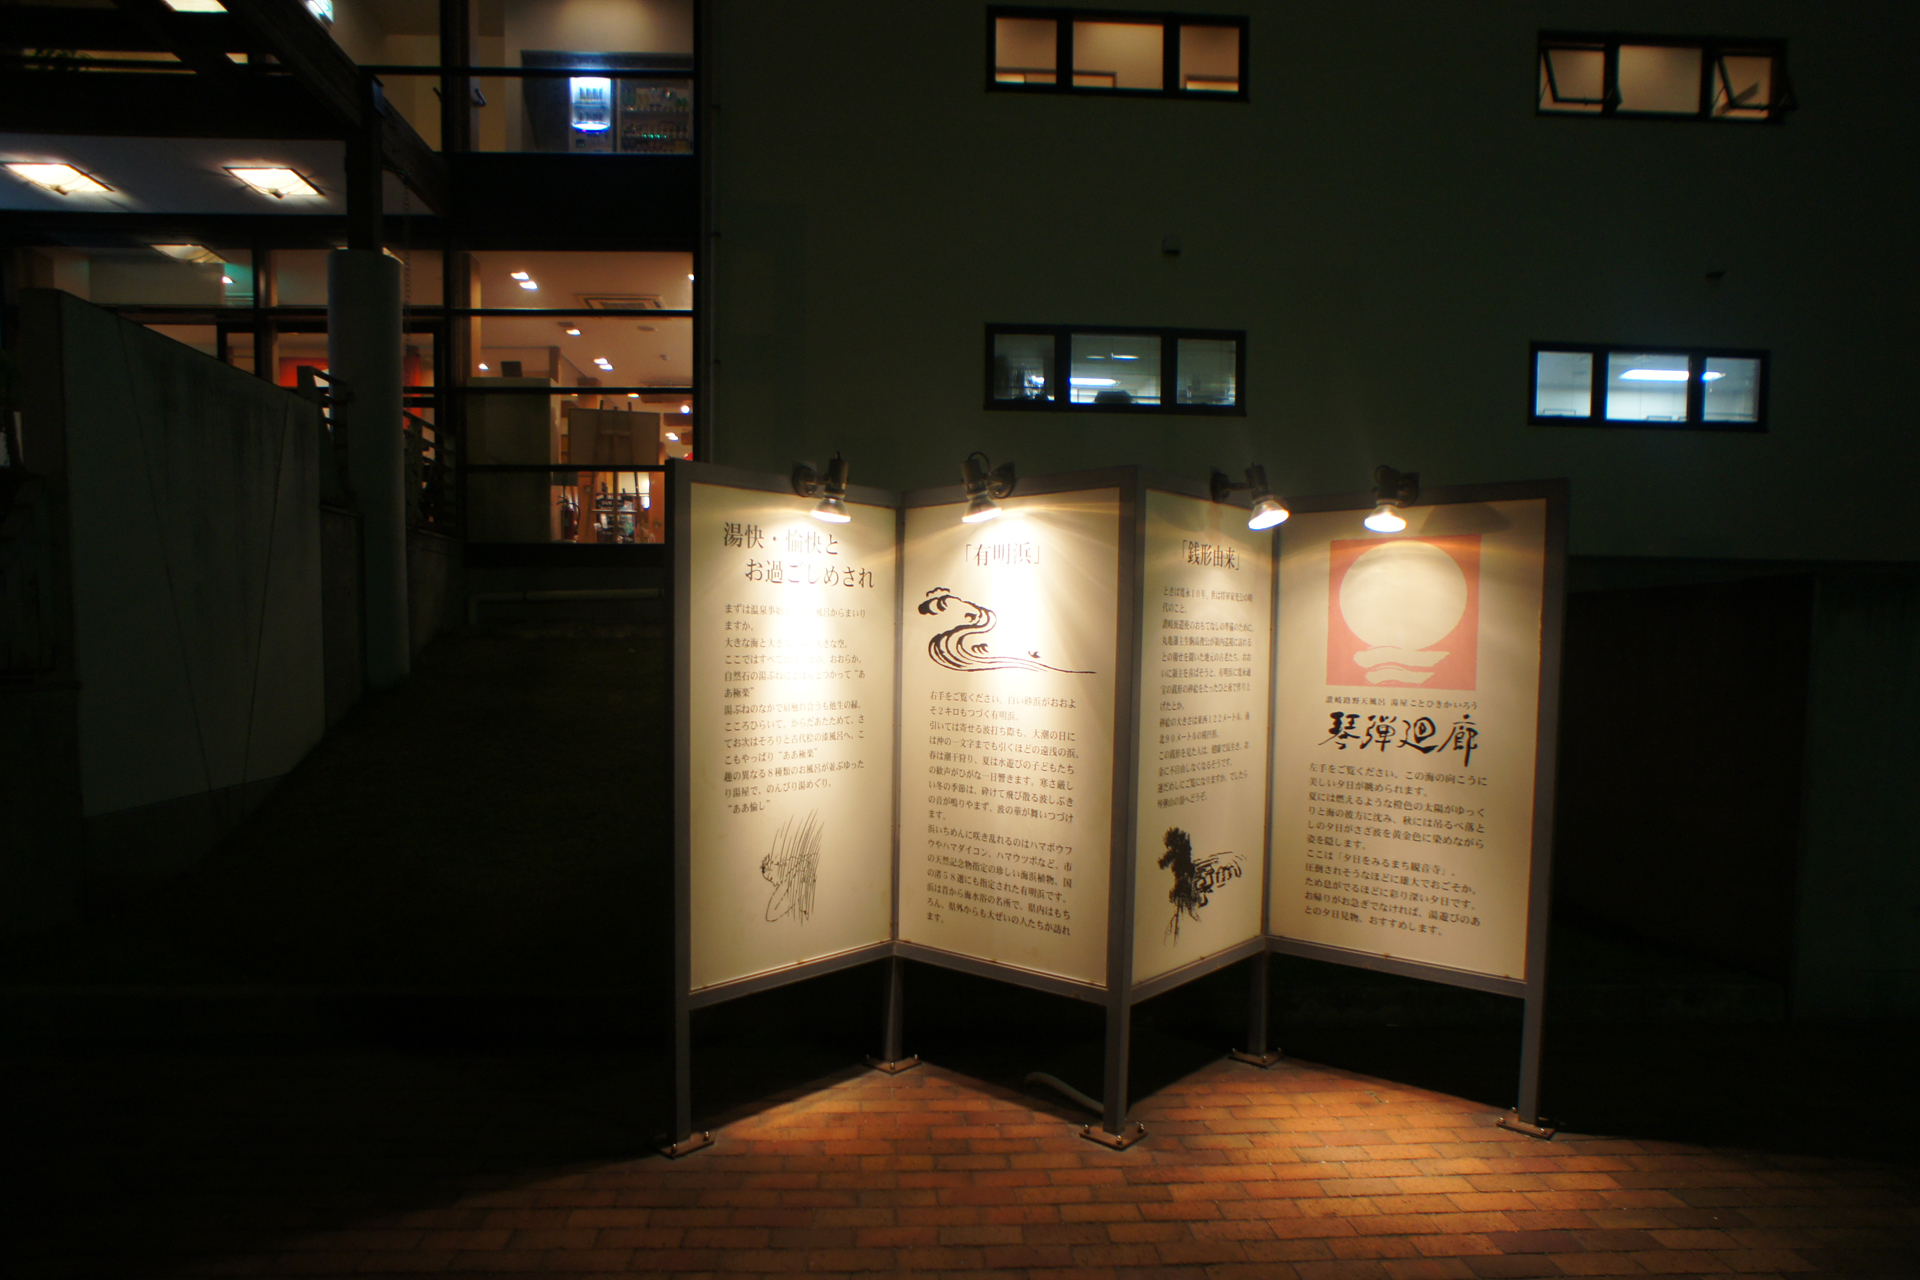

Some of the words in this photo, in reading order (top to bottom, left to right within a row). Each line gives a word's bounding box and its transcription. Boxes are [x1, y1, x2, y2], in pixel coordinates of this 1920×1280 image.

[724, 522, 838, 554] 湯快・愉快と
[966, 542, 1040, 566] 「有明浜」
[1182, 540, 1240, 570] 「銭形由来」
[745, 558, 874, 589] お過ごしめされ
[725, 621, 754, 630] ますか。
[930, 691, 1076, 708] 右手をご覧ください。白い砂浜がおおよ
[929, 721, 1076, 741] 引いては寄せる波打ち際も、大潮の日に
[1318, 711, 1478, 767] 琴弾廻廊
[929, 751, 1075, 774] 春は潮干狩り、夏は水遊びの子どもたち
[1310, 763, 1487, 786] 左手をご覧ください。この海の向こうに
[725, 779, 831, 797] り湯屋で、のんびり湯めぐり。
[929, 781, 1074, 807] い冬の季節は、砕けて飛び散る波しぶき
[1309, 777, 1428, 795] 美しい夕日が眺められます。
[928, 796, 1074, 823] の音が鳴りやまず、波の華が舞いつづけ
[928, 810, 946, 819] ます。
[1309, 792, 1486, 817] 夏には燃えるような橙色の太陽がゆっく
[1307, 821, 1484, 848] しの夕日がさざ波を黄金色に染めながら
[1307, 835, 1366, 849] 姿を隠します。
[1306, 863, 1477, 894] 圧倒されそうなほどに雄大でおごそか。
[927, 883, 1071, 919] 浜は昔から海水浴の名所で、県内はもち
[1305, 878, 1476, 910] ため息がでるほどに彩り深い夕日です。
[927, 898, 1071, 935] ろん、県外からも大ぜいの人たちが訪れ
[927, 912, 944, 923] ます。
[1305, 892, 1481, 926] お帰りがお急ぎでなければ、湯遊びのあ
